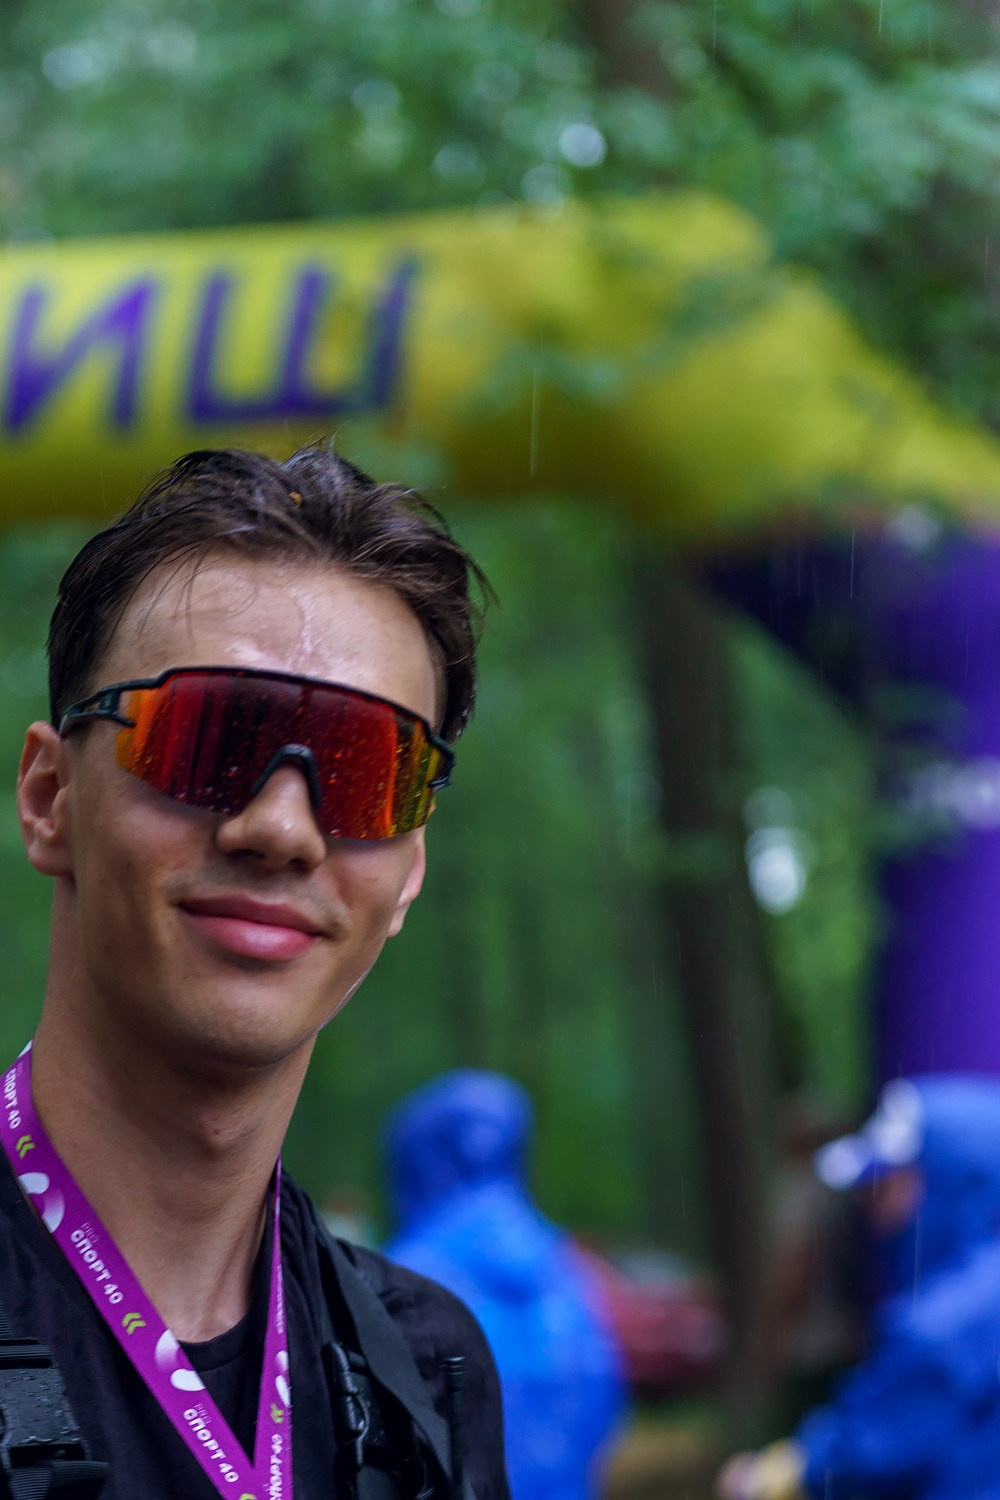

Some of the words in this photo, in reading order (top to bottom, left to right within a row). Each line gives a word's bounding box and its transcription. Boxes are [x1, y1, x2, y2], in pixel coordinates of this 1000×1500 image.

[4, 1068, 18, 1109] СПОРТ
[8, 1107, 22, 1129] 40
[70, 1229, 111, 1283] СПОРТ
[104, 1281, 124, 1305] 40
[182, 1408, 226, 1461] СПОРТ
[219, 1460, 239, 1483] 40
